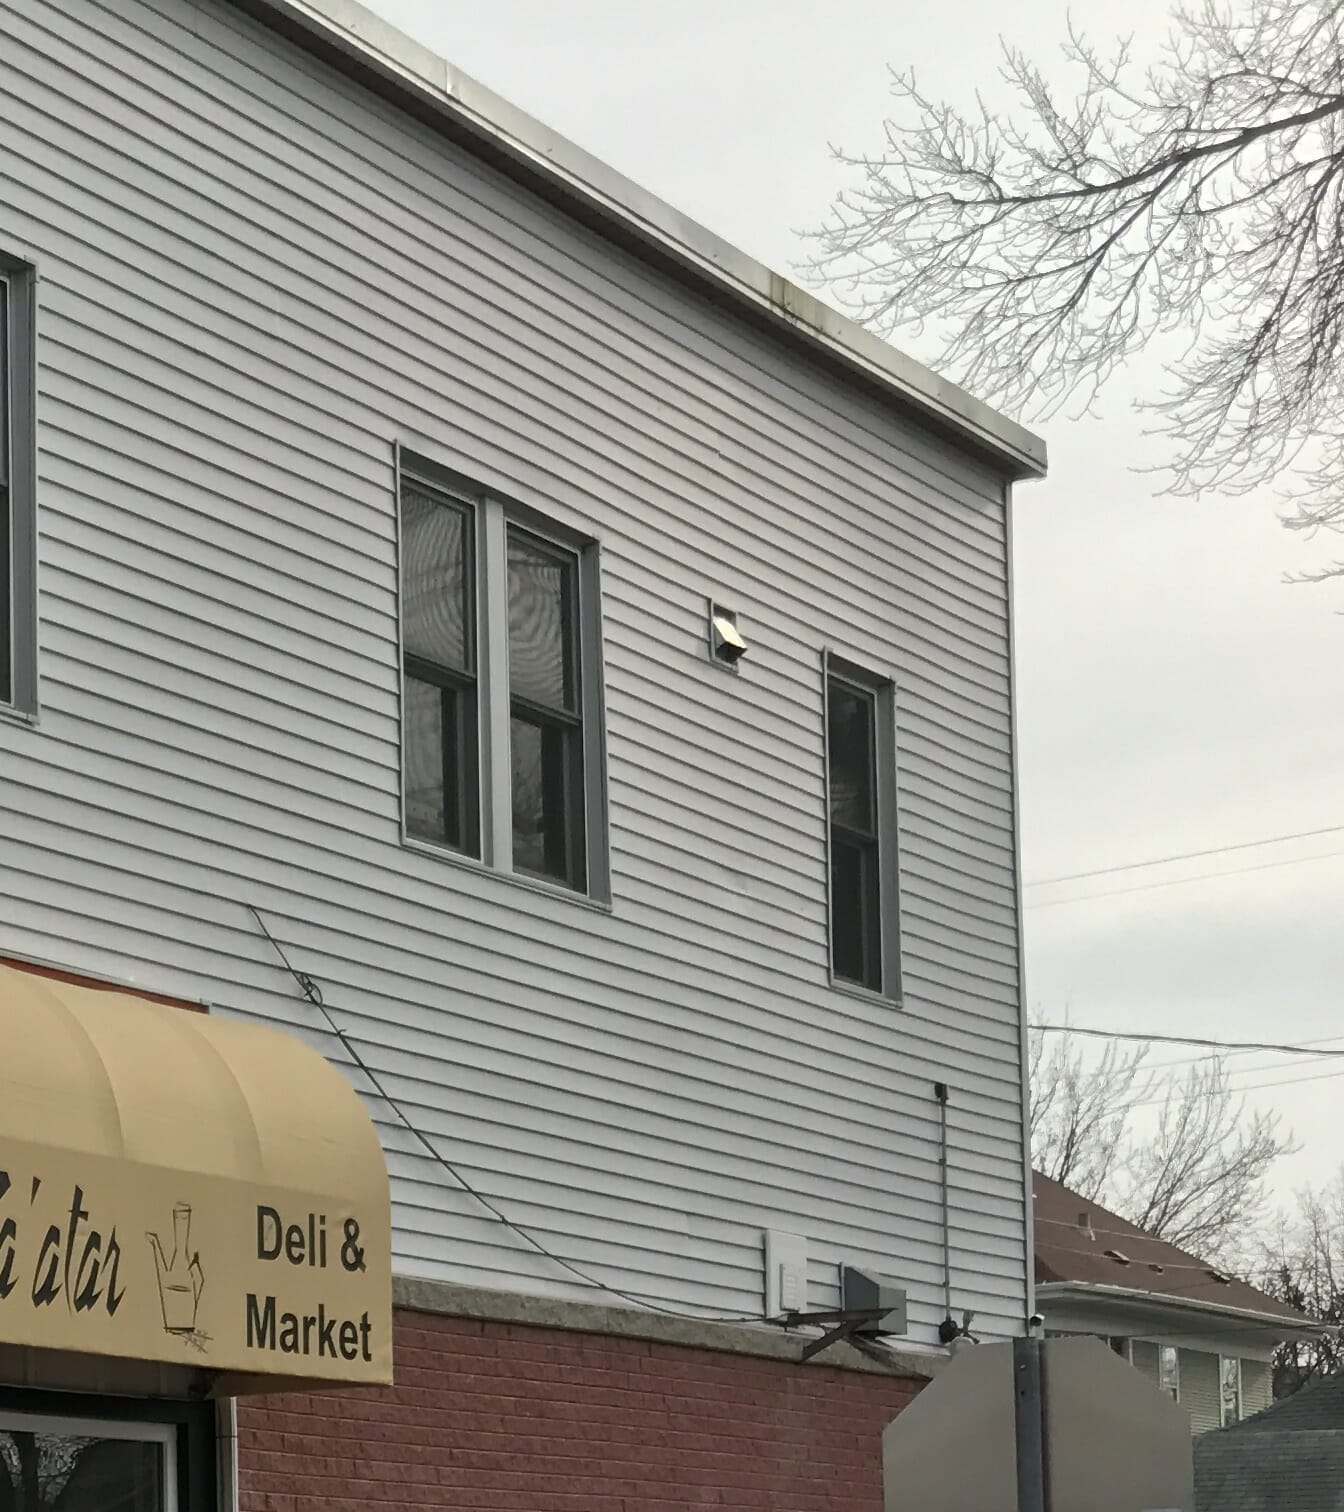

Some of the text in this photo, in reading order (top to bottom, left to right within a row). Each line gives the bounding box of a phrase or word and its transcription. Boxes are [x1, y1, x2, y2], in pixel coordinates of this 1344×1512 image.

[257, 1205, 366, 1272] Deli &
[246, 1293, 372, 1362] Market
